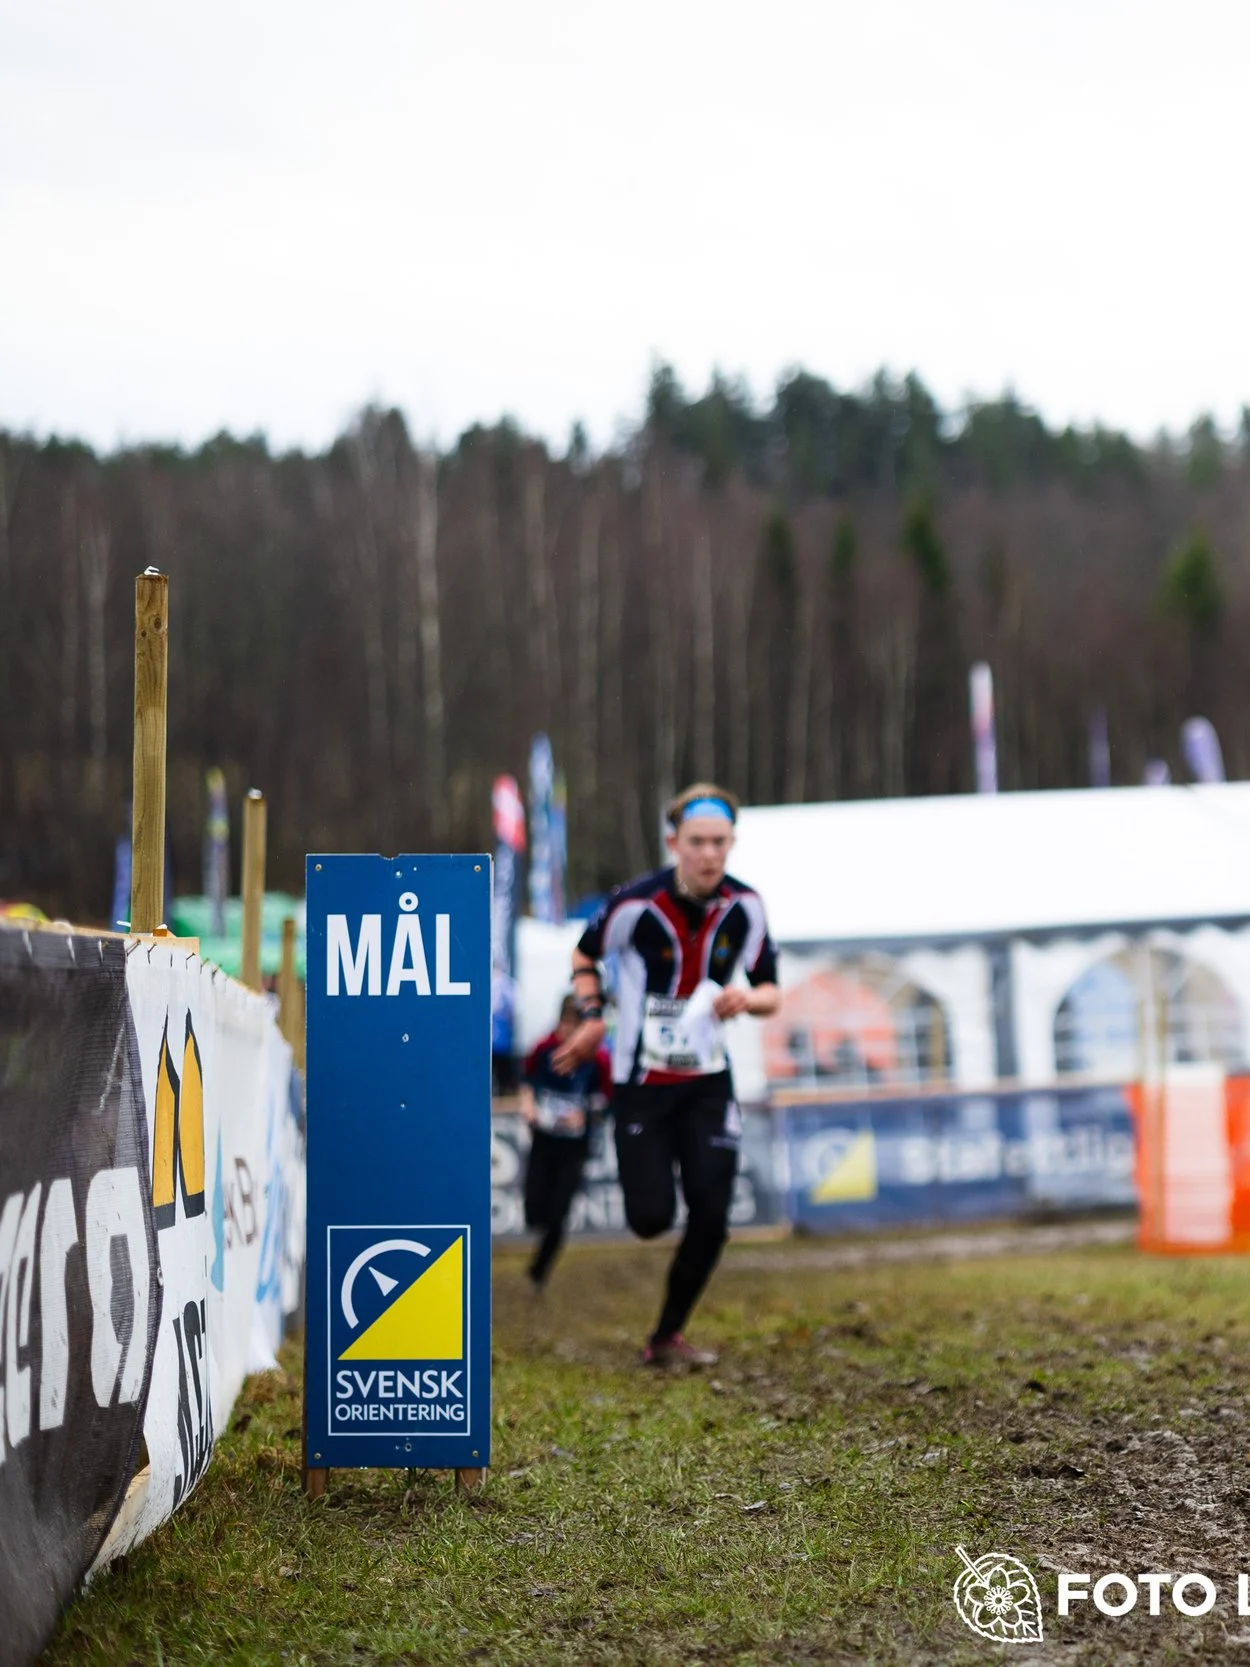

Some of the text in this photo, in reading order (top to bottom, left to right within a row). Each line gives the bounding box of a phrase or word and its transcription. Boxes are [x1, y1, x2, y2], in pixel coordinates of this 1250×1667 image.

[326, 892, 472, 997] MÅL
[335, 1369, 464, 1400] SVENSK
[334, 1404, 465, 1422] ORIENTERING
